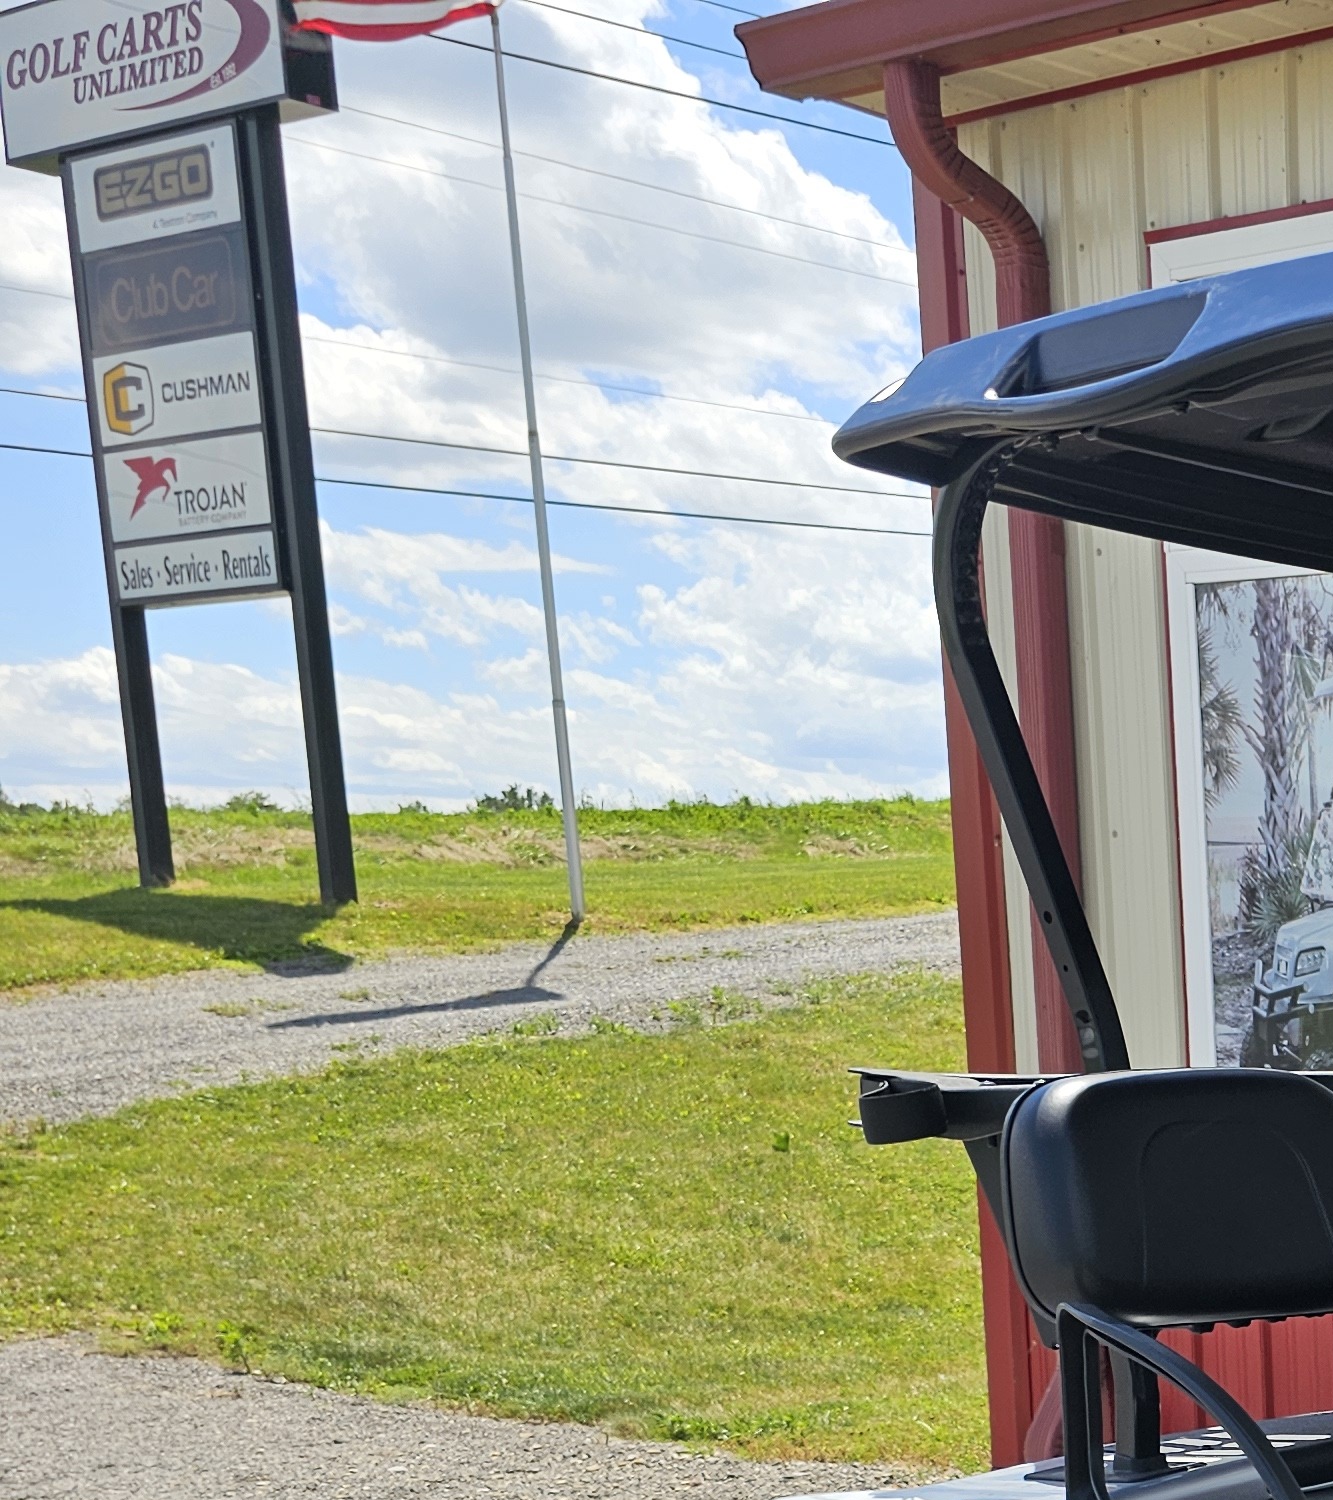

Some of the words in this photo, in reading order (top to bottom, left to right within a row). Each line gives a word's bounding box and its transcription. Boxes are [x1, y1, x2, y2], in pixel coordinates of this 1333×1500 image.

[7, 30, 90, 90] GOLF
[97, 0, 203, 66] CARTS
[73, 47, 204, 104] UNLIMITED
[98, 153, 208, 214] EZGO
[111, 273, 169, 323] Club
[172, 266, 218, 312] Car
[161, 370, 250, 403] CUSHMAN
[174, 481, 246, 514] TROJAN
[121, 559, 154, 590] Sales
[163, 553, 211, 586] Service
[222, 545, 271, 580] Rentals
